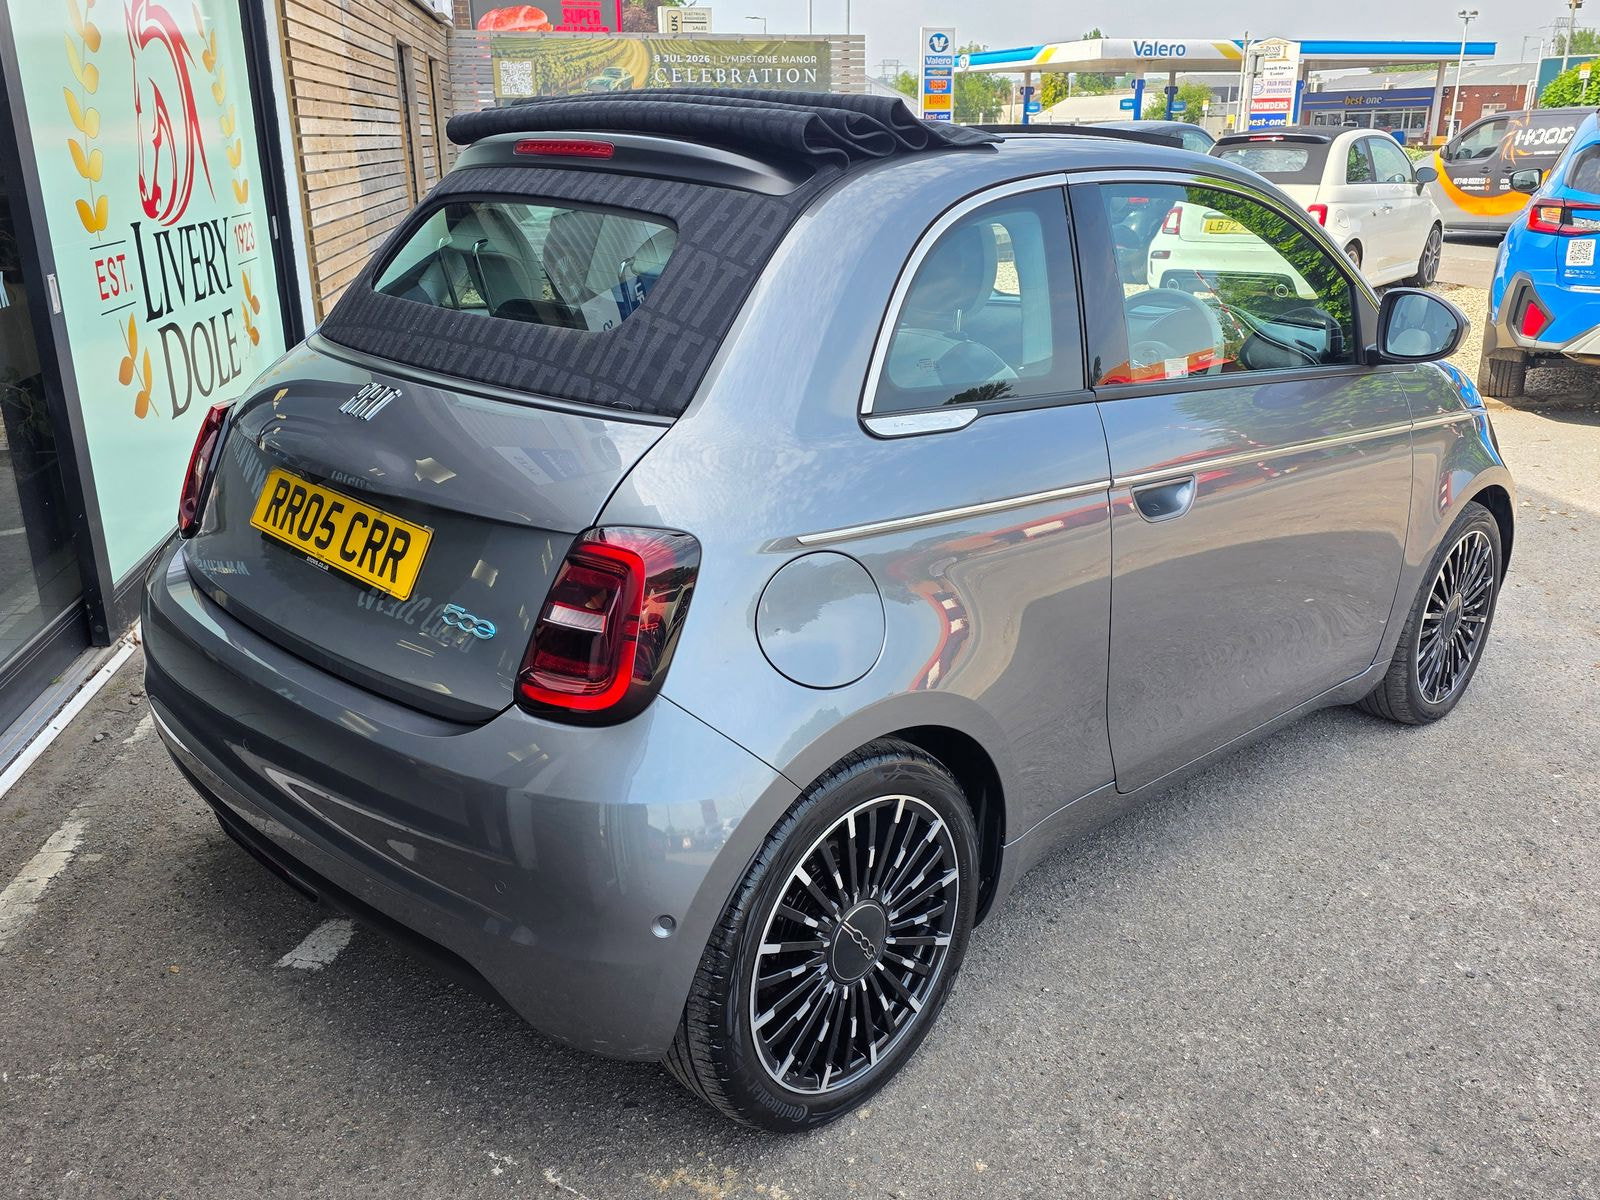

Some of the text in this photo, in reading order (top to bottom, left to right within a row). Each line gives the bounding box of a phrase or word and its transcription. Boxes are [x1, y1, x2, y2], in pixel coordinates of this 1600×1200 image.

[562, 8, 601, 25] SUPER
[1133, 40, 1186, 56] Valero
[664, 55, 682, 63] JUL
[686, 55, 710, 63] 2026
[926, 56, 951, 65] Valero
[654, 68, 817, 83] CELEBRATION
[1253, 101, 1289, 110] HOWDENS
[1344, 95, 1383, 105] best-one
[1209, 221, 1237, 231] LB72
[234, 222, 256, 255] 1923
[95, 255, 135, 301] EST.
[131, 217, 233, 323] LIVERY
[158, 307, 242, 420] DOLE
[339, 382, 403, 421] FIAT
[263, 477, 411, 584] RR05 CRR
[441, 603, 496, 640] 500
